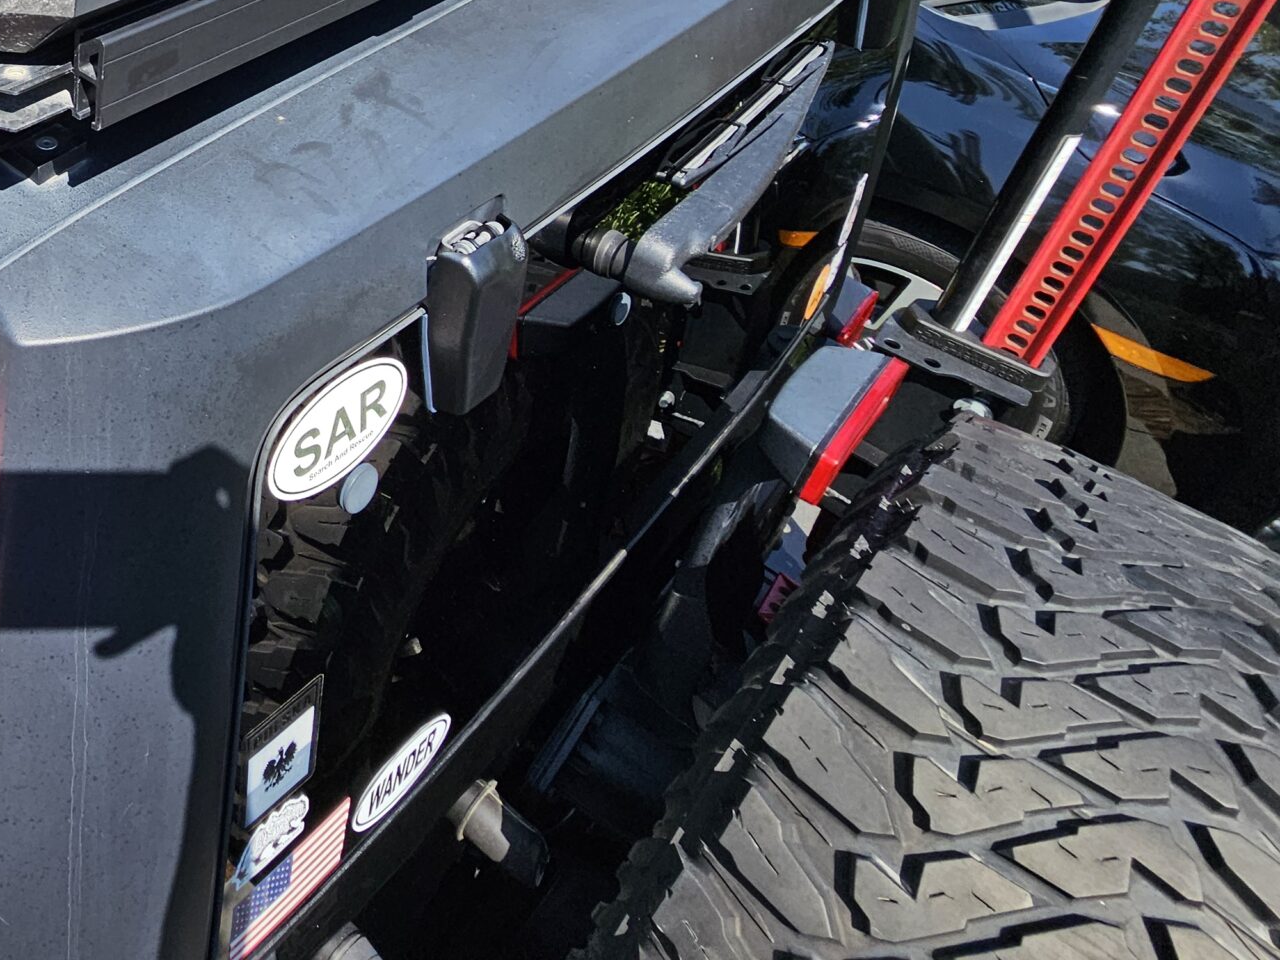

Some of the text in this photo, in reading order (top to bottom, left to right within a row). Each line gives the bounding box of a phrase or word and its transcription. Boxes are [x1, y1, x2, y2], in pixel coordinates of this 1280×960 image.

[293, 379, 388, 478] SAR
[308, 430, 374, 481] Search And Rescue
[367, 727, 438, 817] WANDER
